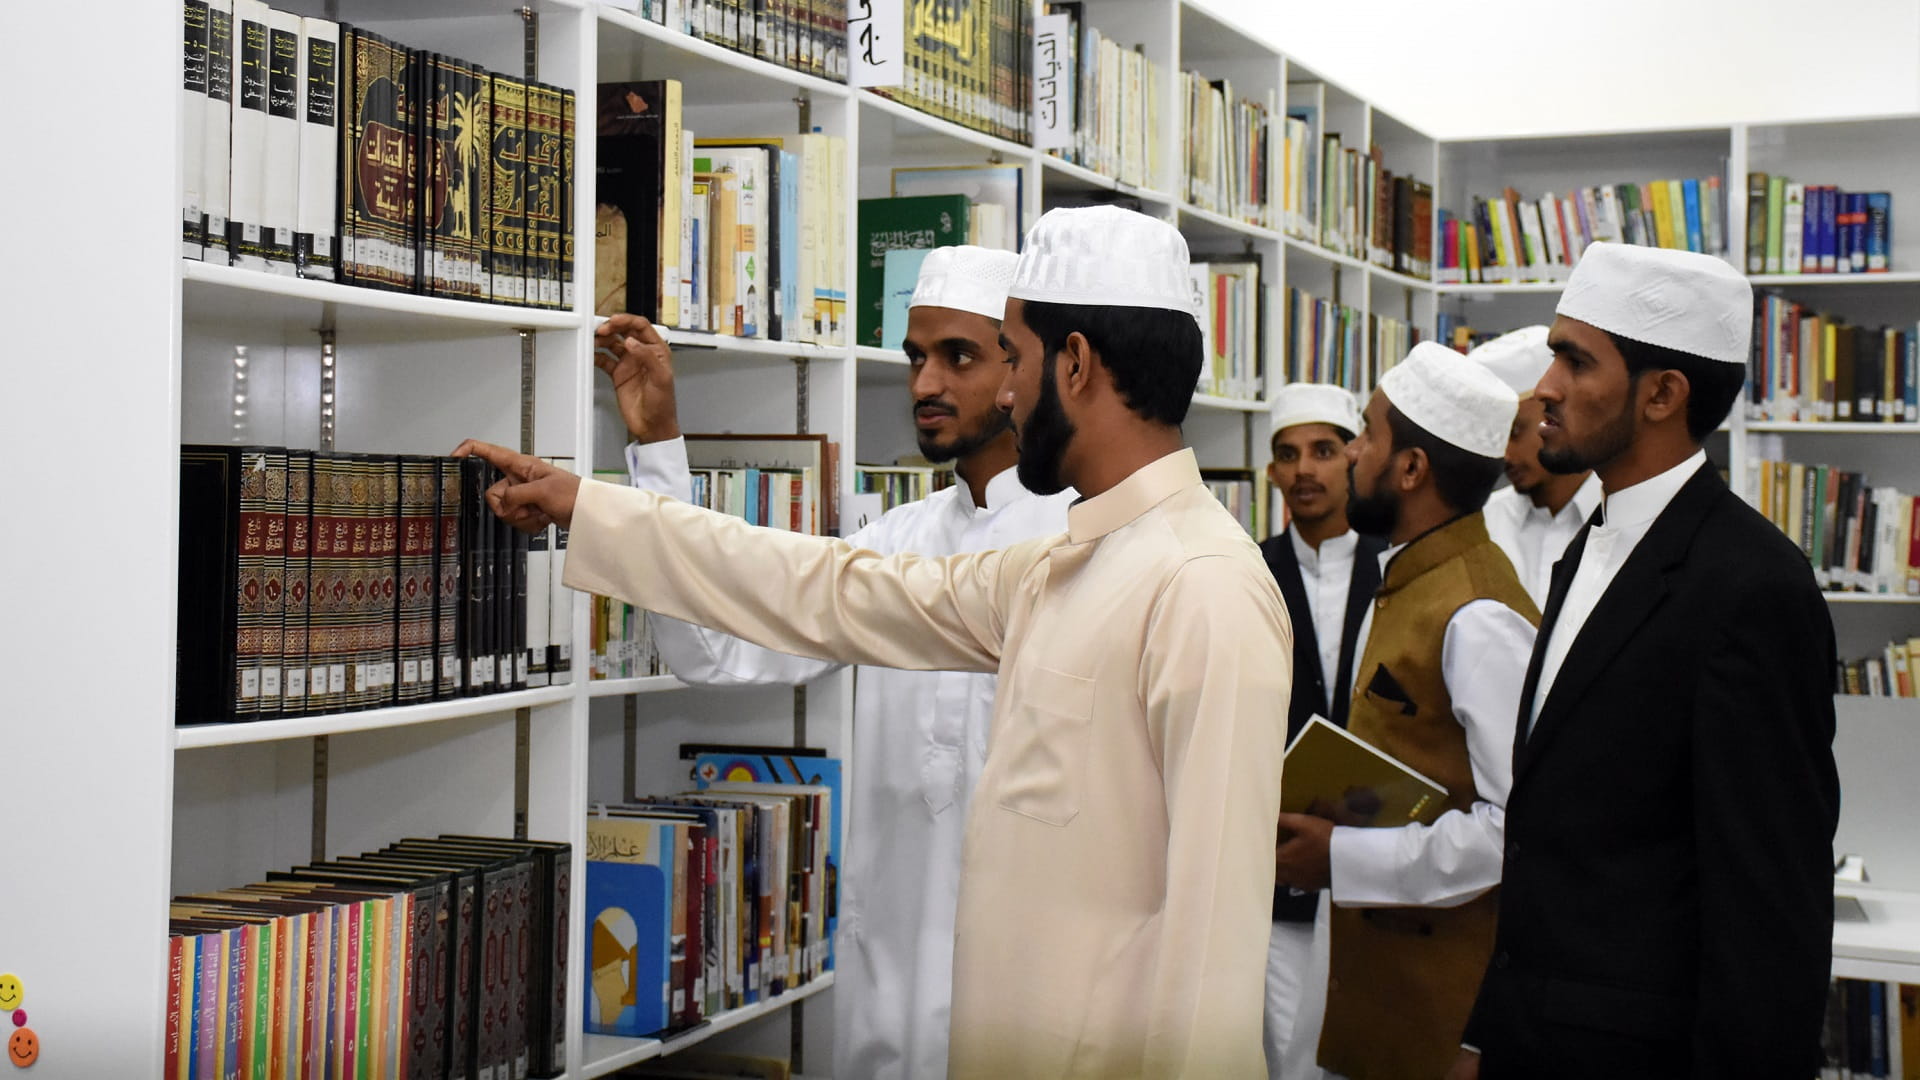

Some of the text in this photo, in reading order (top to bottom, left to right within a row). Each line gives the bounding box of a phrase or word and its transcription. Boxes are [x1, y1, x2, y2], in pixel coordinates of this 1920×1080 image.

[1037, 33, 1062, 129] الديانات
[250, 585, 255, 595] ١١
[269, 586, 277, 597] ١٠
[349, 1040, 353, 1051] ٥
[258, 1063, 265, 1077] ١١
